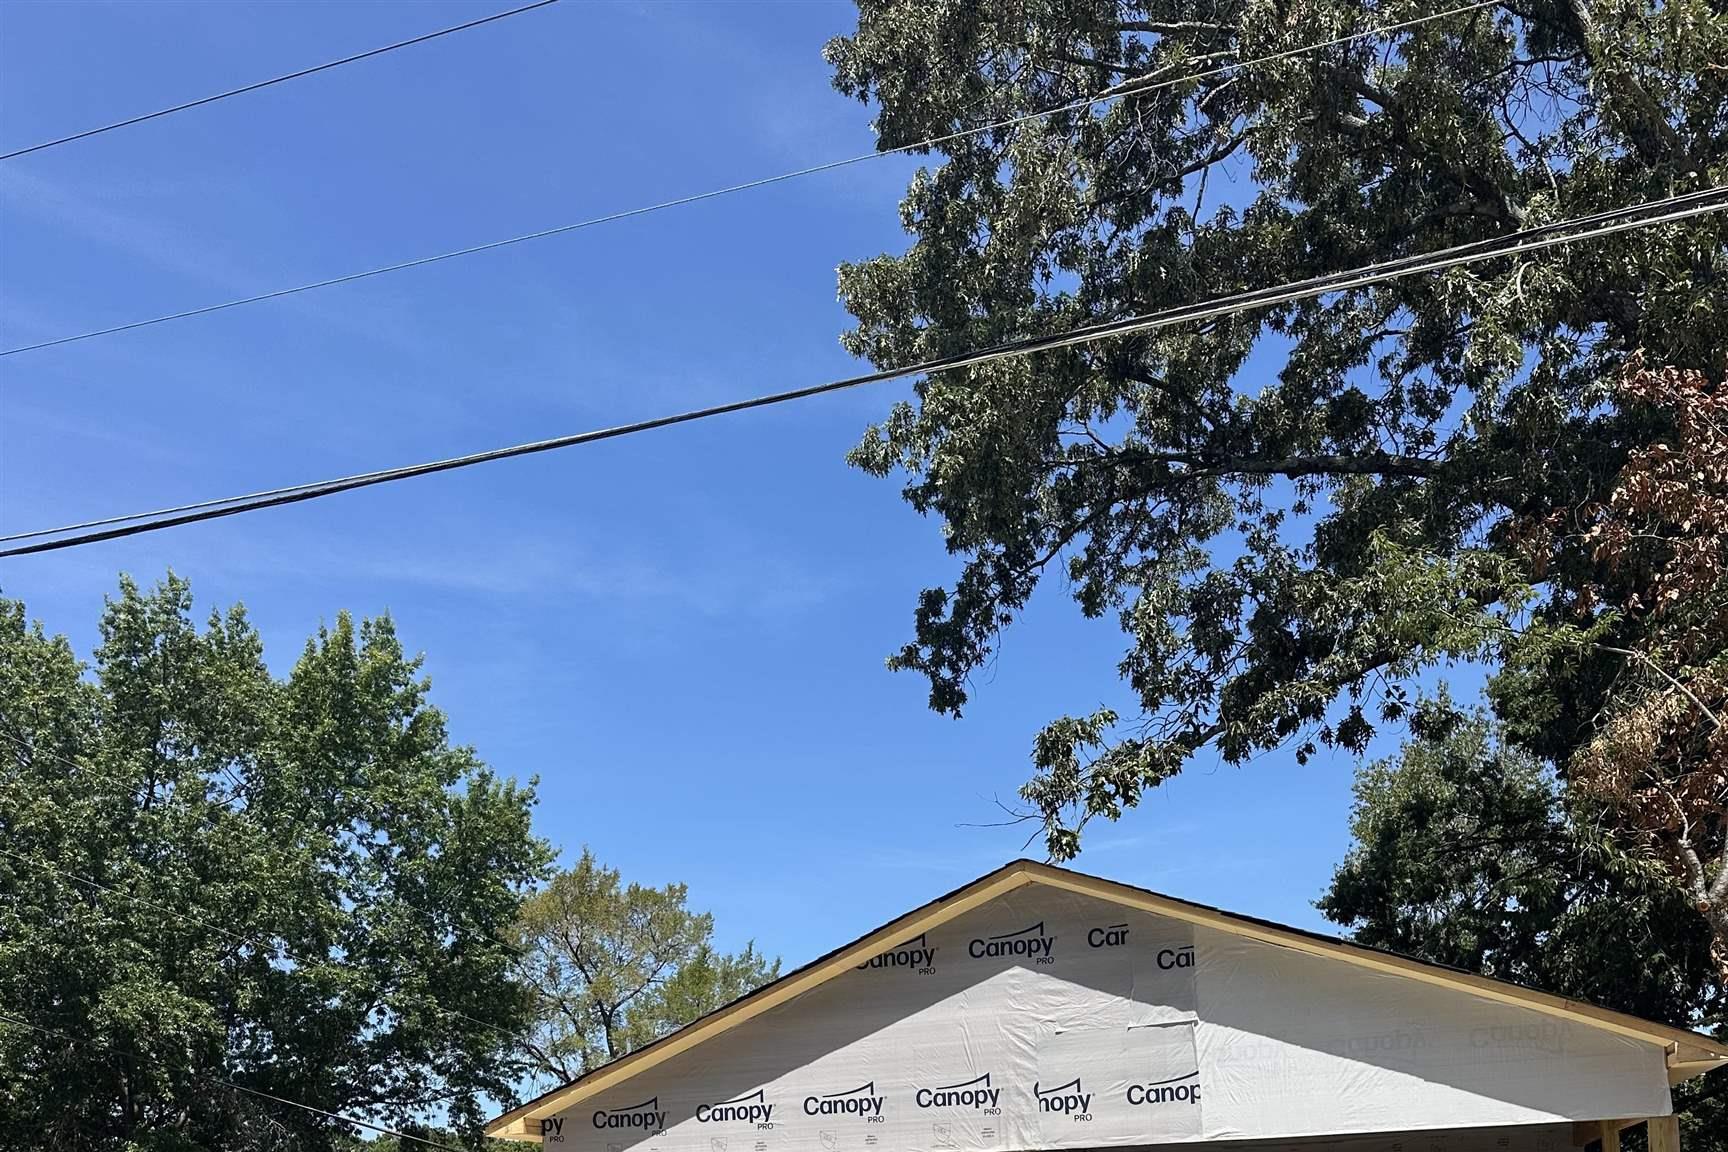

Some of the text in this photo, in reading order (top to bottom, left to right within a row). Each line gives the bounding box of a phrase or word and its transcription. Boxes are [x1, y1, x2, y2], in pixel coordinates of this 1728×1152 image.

[969, 937, 1054, 958] Canopy
[856, 947, 935, 970] anopy
[1036, 957, 1055, 965] PRO
[918, 967, 936, 975] PRO
[916, 1088, 1000, 1109] Canopy
[804, 1096, 884, 1116] Canopy
[696, 1103, 773, 1123] Canopy
[983, 1108, 1001, 1116] PRO
[592, 1111, 666, 1130] Canopy
[867, 1115, 885, 1123] PRO
[1074, 1113, 1093, 1122] PRO
[757, 1122, 774, 1130] PRO
[651, 1129, 668, 1137] PRO
[550, 1135, 565, 1143] PRO
